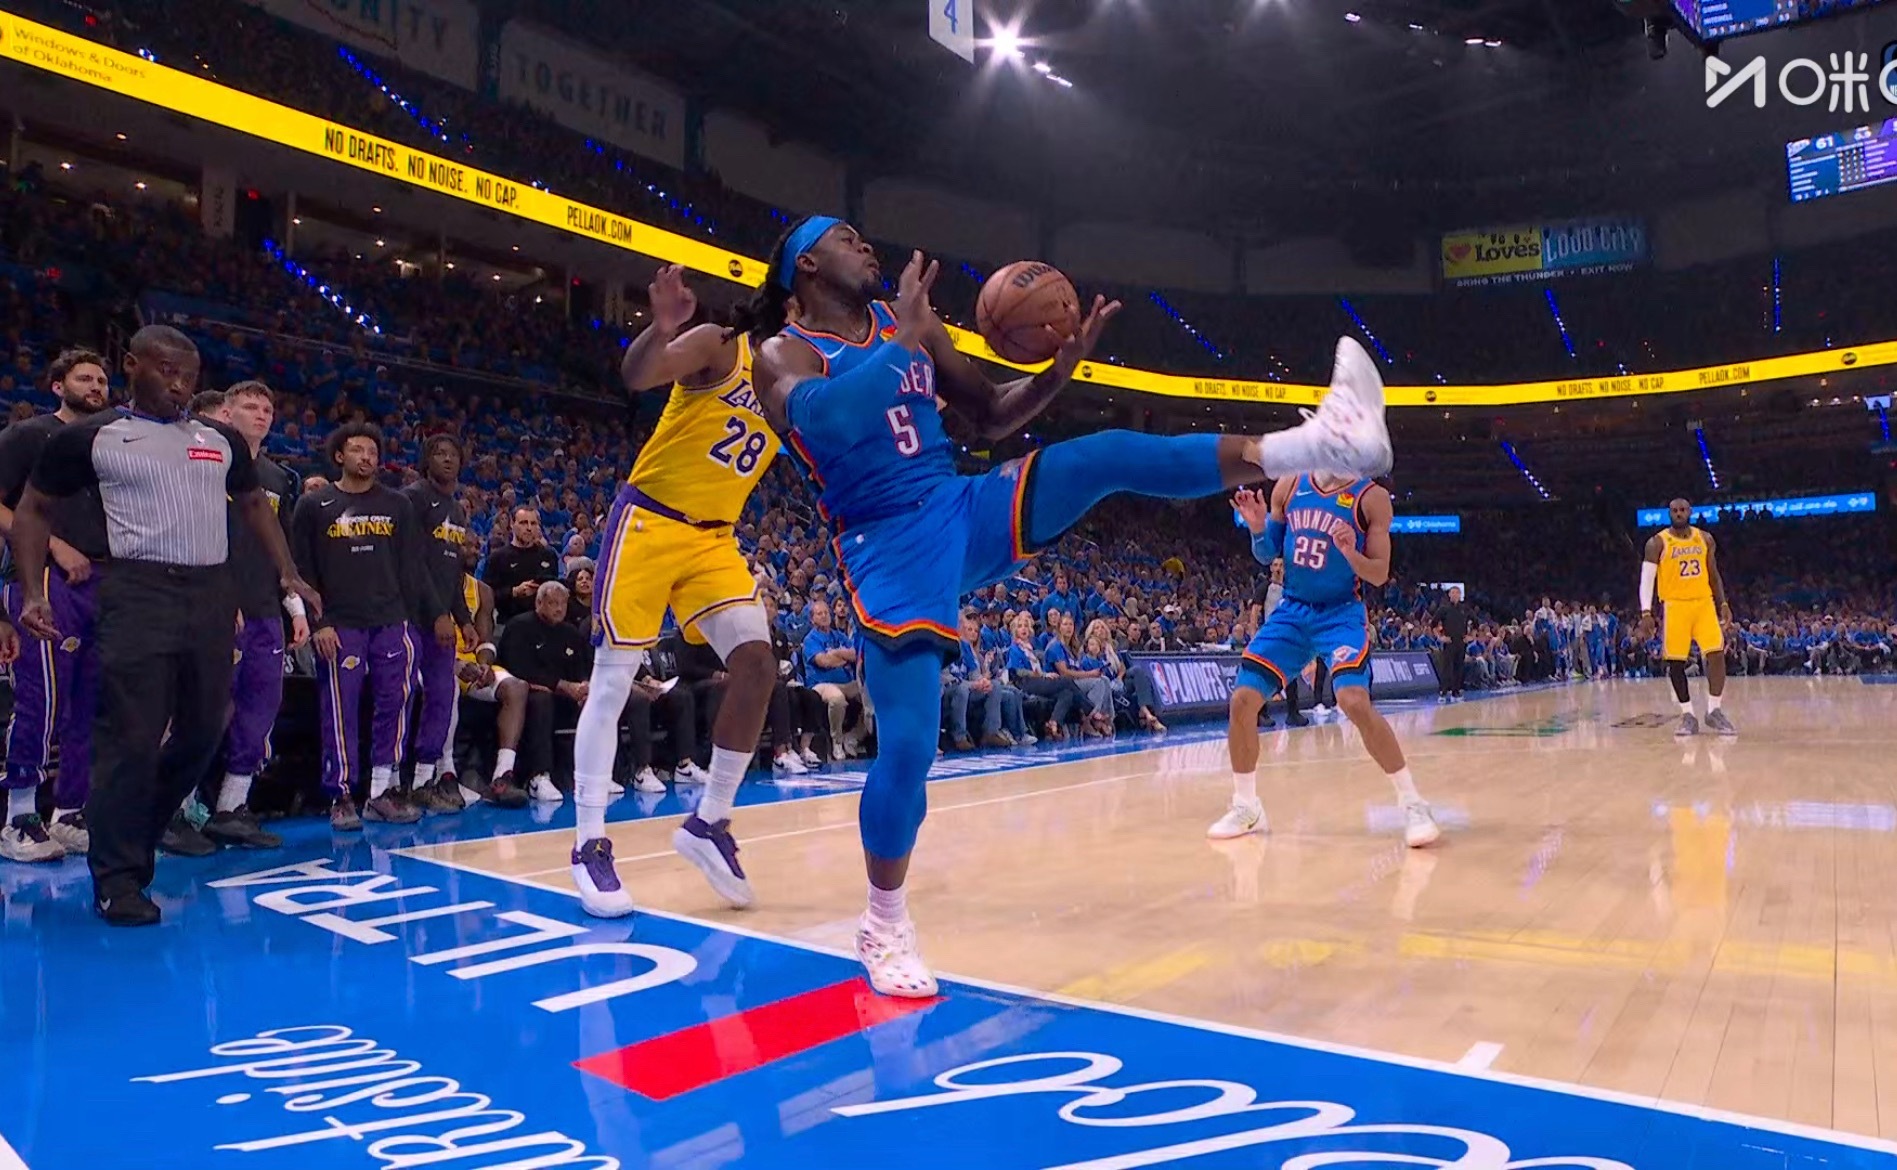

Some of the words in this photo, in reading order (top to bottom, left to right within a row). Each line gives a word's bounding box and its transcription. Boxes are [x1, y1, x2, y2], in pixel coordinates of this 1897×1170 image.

[13, 44, 29, 57] of
[33, 50, 113, 84] Oklahoma
[14, 27, 86, 59] Windows
[89, 52, 101, 65] &
[103, 57, 146, 79] Doors
[516, 52, 667, 140] TOGETHER
[1816, 136, 1833, 149] 61
[325, 127, 343, 155] NO
[349, 140, 398, 172] DRAFTS.
[408, 155, 424, 180] NO
[429, 163, 467, 194] NOISE.
[475, 176, 491, 200] NO
[495, 183, 519, 209] CAP.
[567, 205, 632, 243] PELLAOK.COM
[1491, 274, 1512, 284] THE
[1514, 270, 1565, 283] THUNDER
[1581, 264, 1605, 275] EXIT
[1194, 381, 1203, 395] NO
[1231, 384, 1240, 397] NO
[1265, 386, 1273, 400] NO
[1557, 383, 1566, 397] NO
[1599, 380, 1608, 393] NO
[1639, 377, 1648, 391] NO
[1698, 366, 1750, 385] PELLAOK.COM
[708, 414, 767, 479] 28
[887, 403, 920, 455] 5
[1293, 535, 1328, 569] 25
[1672, 545, 1703, 559] LAKERS
[1679, 559, 1701, 577] 23
[1163, 662, 1227, 703] PLAYOFFS
[207, 858, 698, 1013] ULTRA
